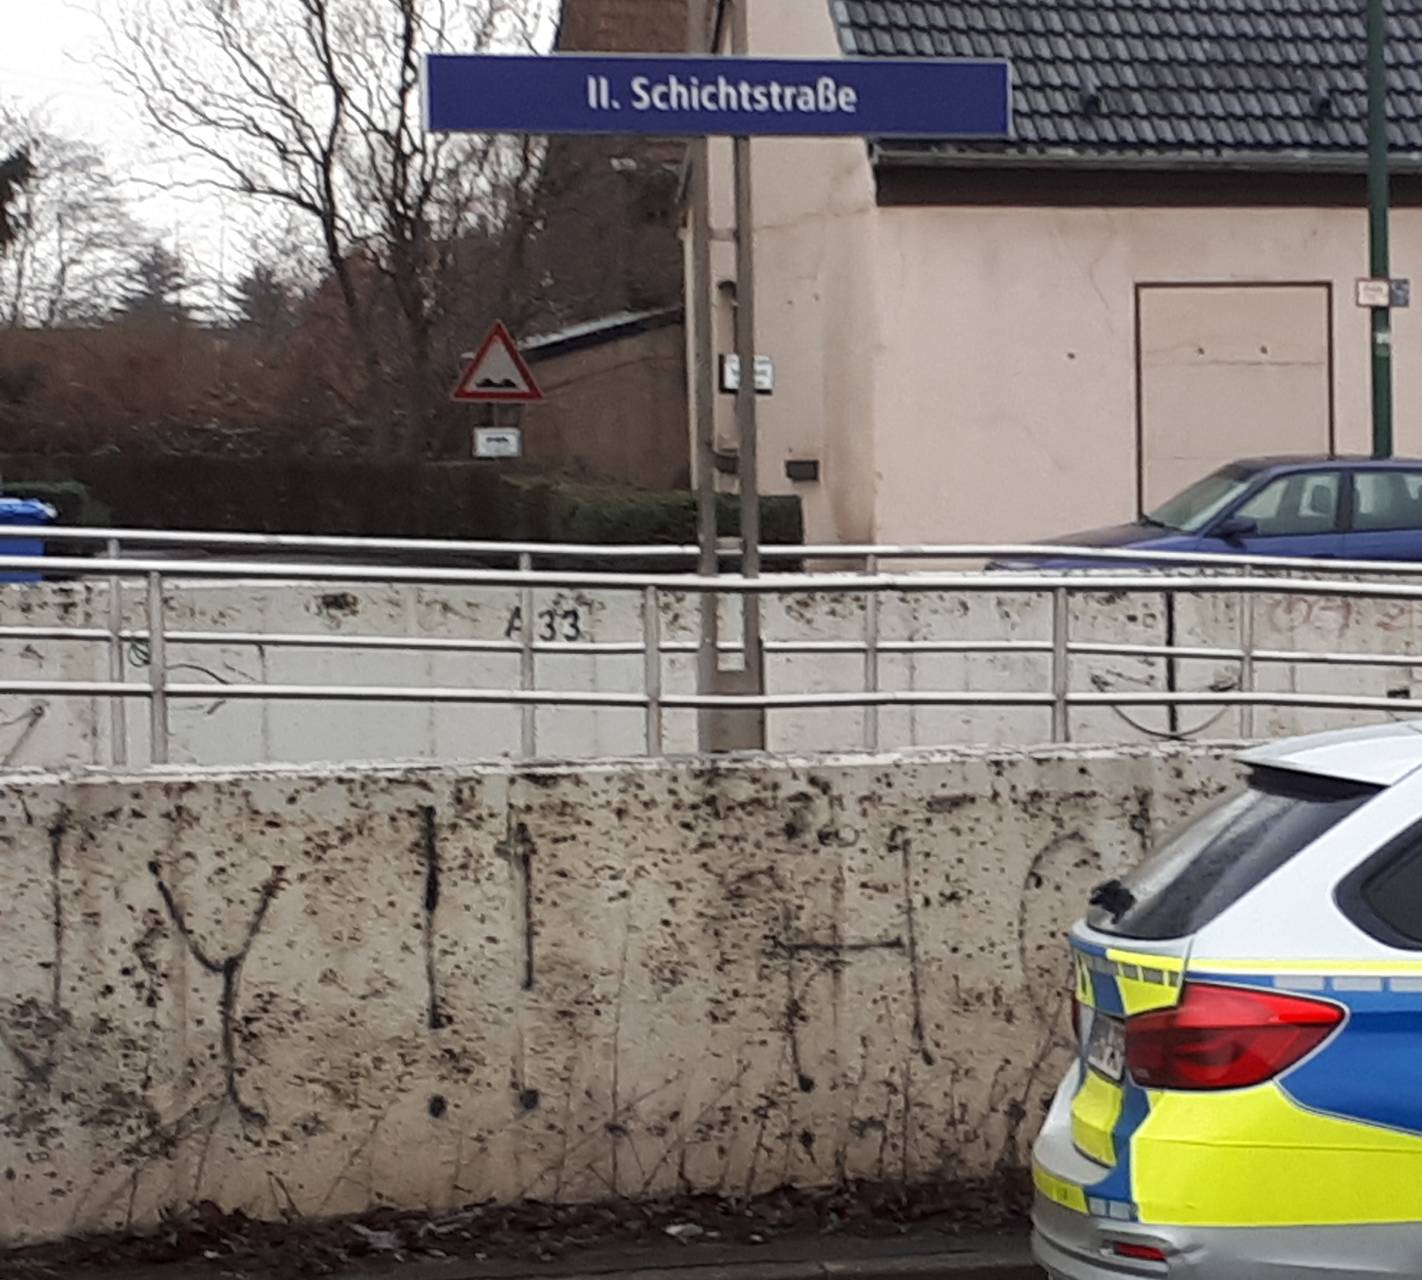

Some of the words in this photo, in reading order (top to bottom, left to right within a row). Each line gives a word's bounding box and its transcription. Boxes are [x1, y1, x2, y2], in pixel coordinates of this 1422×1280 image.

[587, 74, 622, 111] II.
[630, 74, 858, 113] Schichtstraße
[537, 608, 581, 641] 33
